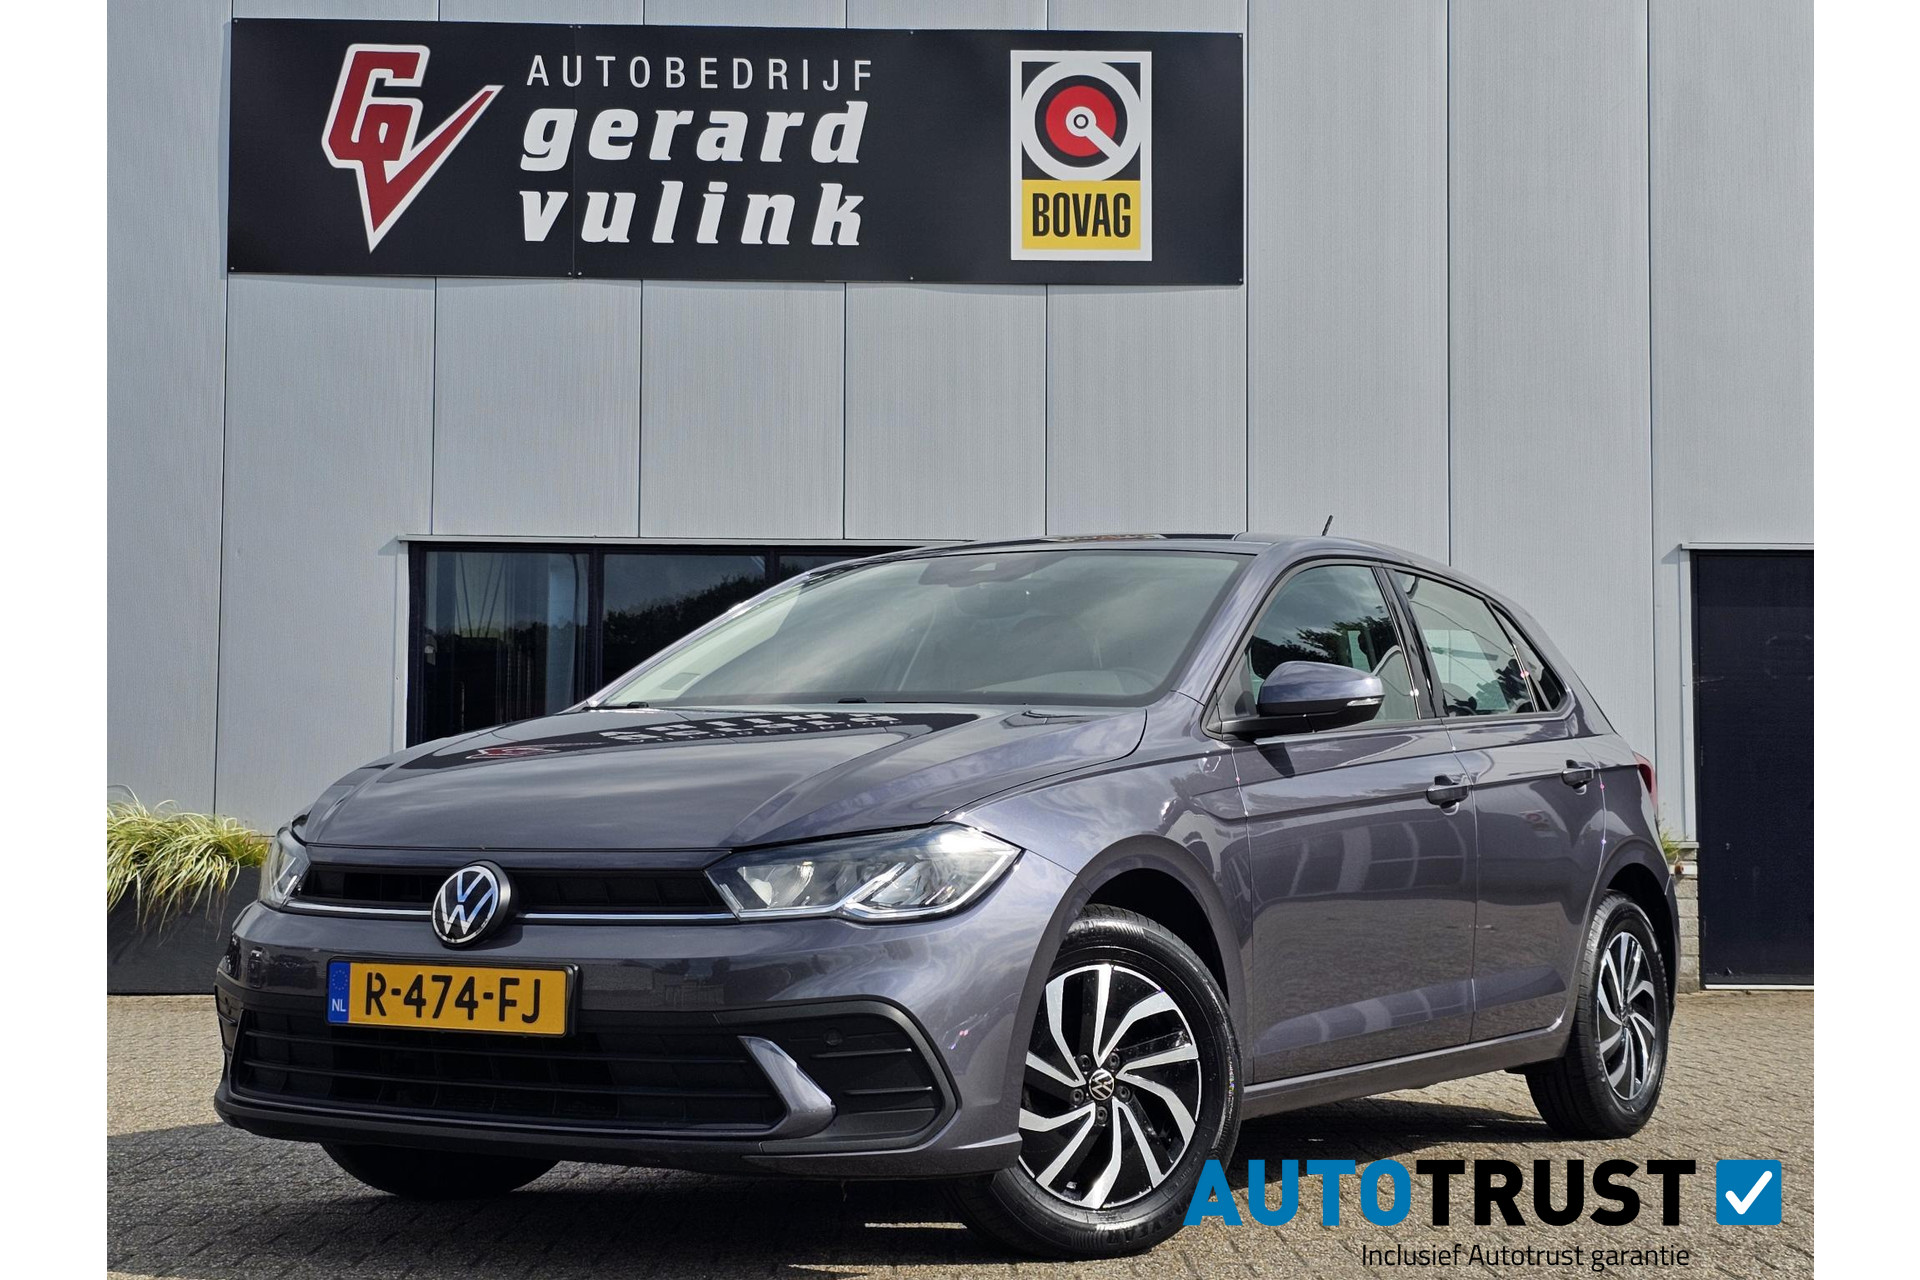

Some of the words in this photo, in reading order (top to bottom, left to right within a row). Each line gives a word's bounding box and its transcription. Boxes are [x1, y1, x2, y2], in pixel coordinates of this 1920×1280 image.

[526, 54, 872, 92] AUTOBEDRIJF
[520, 100, 869, 172] gerard
[519, 180, 864, 247] vulink
[1032, 192, 1131, 238] BOVAG
[331, 998, 347, 1012] NL
[365, 971, 541, 1024] R-474-FJ
